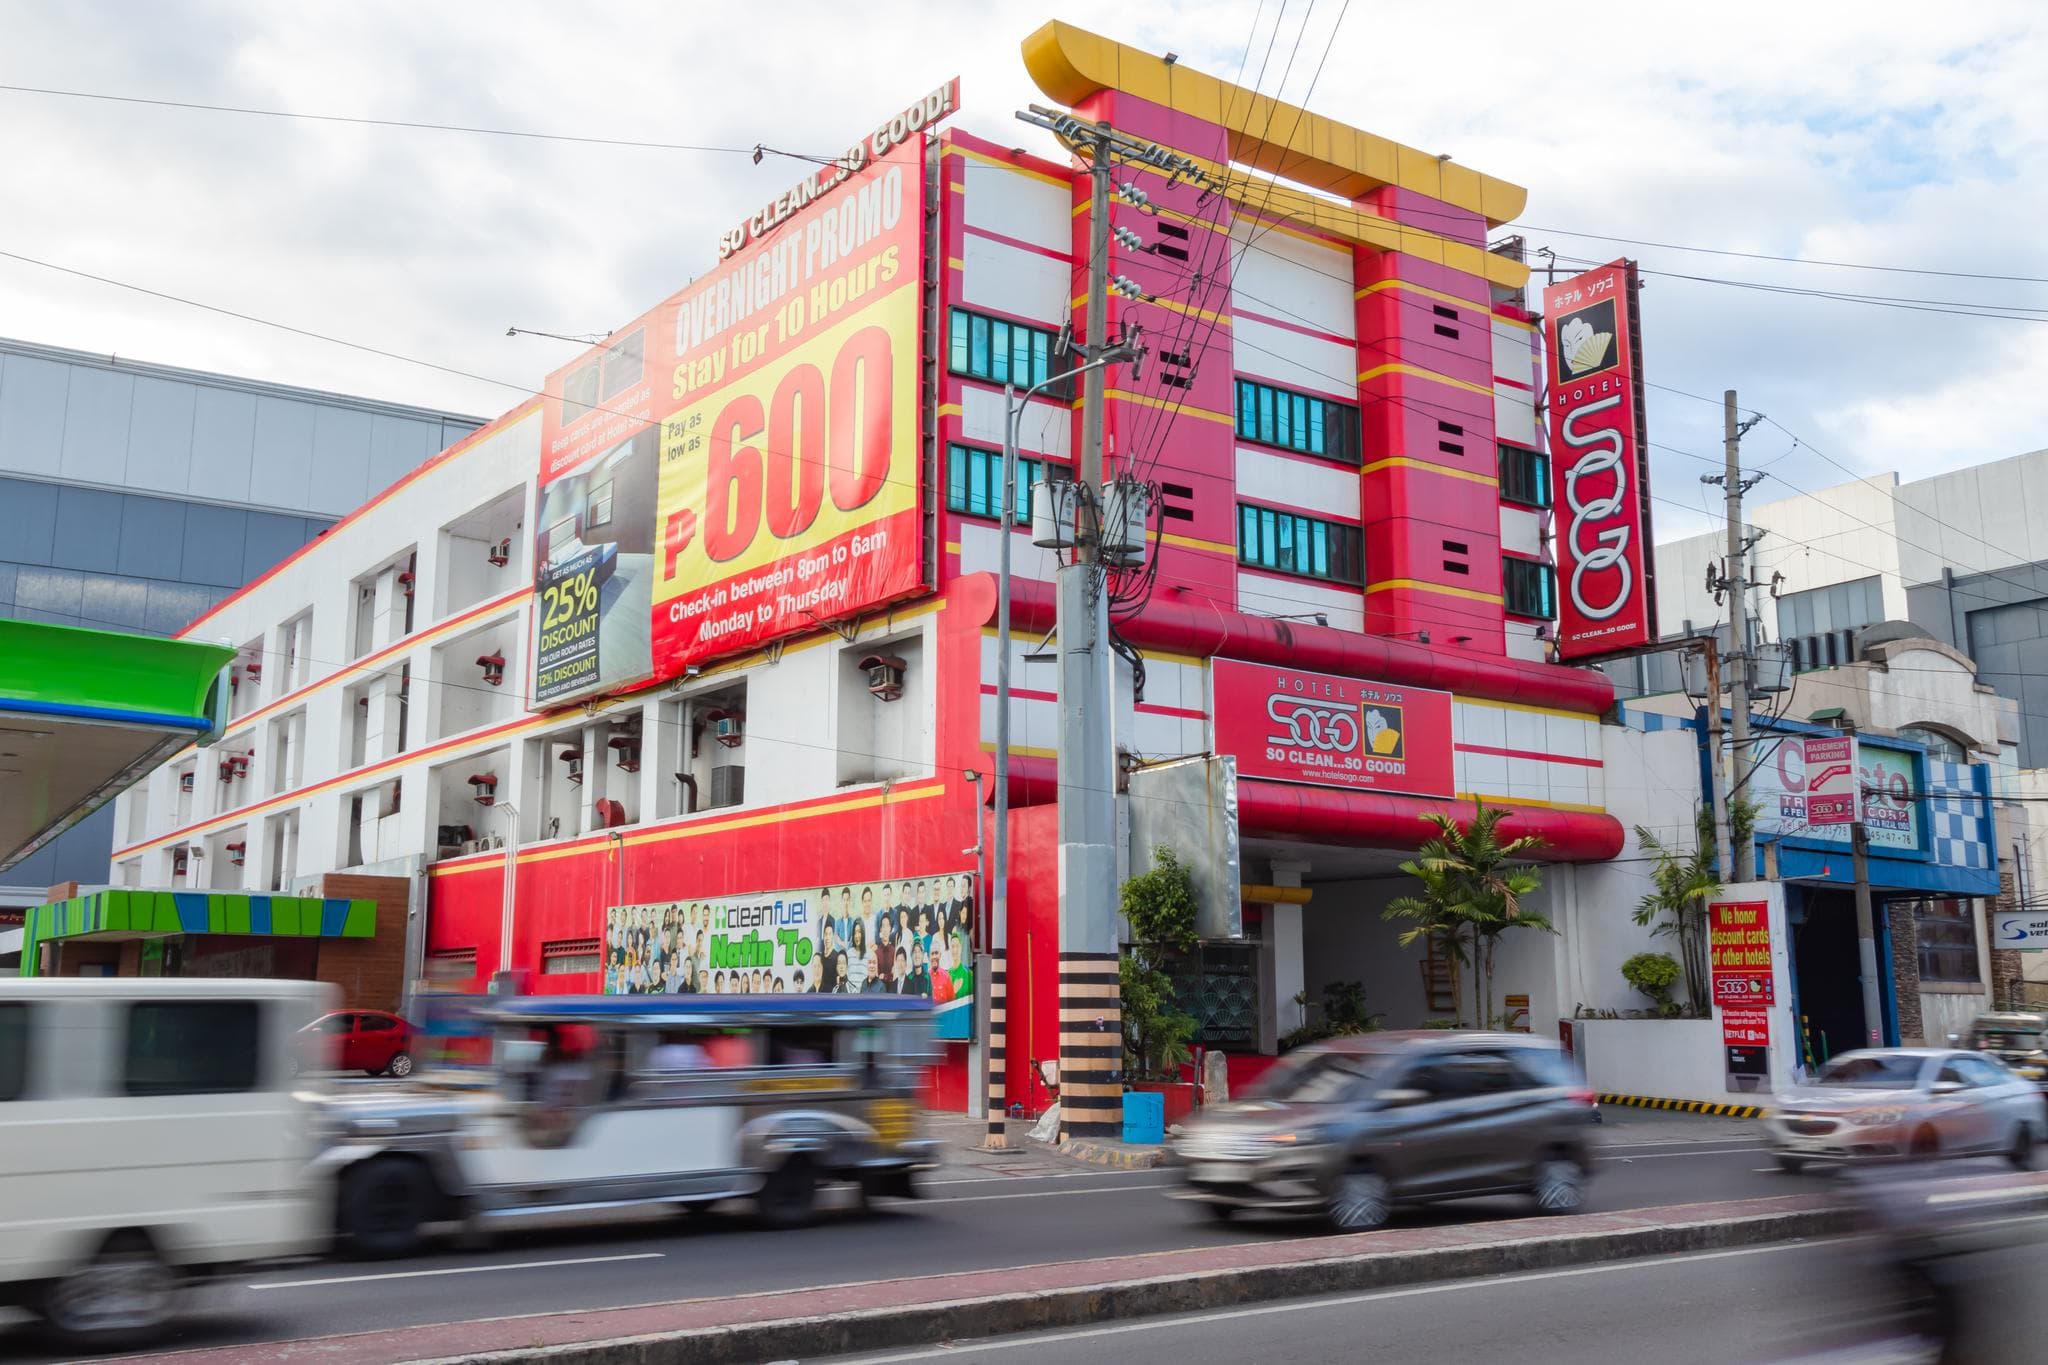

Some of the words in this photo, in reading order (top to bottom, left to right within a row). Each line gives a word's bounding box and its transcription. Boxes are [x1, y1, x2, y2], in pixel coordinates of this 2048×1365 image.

[719, 222, 748, 259] SO
[871, 79, 954, 157] GOOD!
[675, 229, 803, 357] OVERNIGHT
[804, 165, 903, 280] PROMO
[1553, 288, 1582, 309] ホテル
[1587, 273, 1615, 298] ソウゴ
[672, 345, 727, 400] Stay
[731, 321, 770, 370] for
[774, 295, 806, 345] 10
[810, 244, 900, 326] Hours
[1558, 376, 1622, 407] HOTEL
[668, 418, 687, 440] Pay
[689, 412, 702, 427] as
[550, 447, 580, 474] discount
[580, 435, 597, 456] card
[597, 431, 606, 446] at
[667, 443, 686, 462] low
[688, 434, 701, 452] as
[1562, 393, 1634, 621] SOGO
[669, 588, 728, 623] Check-in
[730, 565, 794, 601] between
[797, 552, 830, 580] 8pm
[832, 545, 847, 564] to
[851, 530, 887, 558] 6am
[543, 567, 598, 631] 25%
[699, 609, 754, 642] Monday
[757, 603, 773, 623] to
[776, 577, 848, 617] Thursday
[540, 613, 598, 652] DISCOUNT
[1572, 633, 1581, 641] SO
[1616, 622, 1637, 632] GOOD!
[540, 655, 549, 665] ON
[549, 650, 561, 662] OUR
[560, 643, 578, 657] ROOM
[578, 636, 596, 650] RATES
[538, 672, 553, 688] 12%
[553, 655, 597, 683] DISCOUNT
[1278, 677, 1345, 698] HOTEL
[1267, 692, 1359, 753] SOGO
[1265, 747, 1286, 762] SO
[1365, 759, 1406, 775] GOOD!
[1806, 741, 1849, 753] BASEMENT
[1810, 750, 1846, 761] PARKING
[1302, 768, 1375, 784] www.hotelsogo.com
[1867, 807, 1909, 822] CORP.
[727, 898, 808, 929] cleanfuel
[1720, 905, 1733, 925] We
[1733, 906, 1757, 925] honor
[709, 928, 774, 970] Natin
[1711, 926, 1745, 945] discount
[1746, 926, 1769, 945] cards
[1712, 947, 1720, 966] of
[1722, 947, 1744, 966] other
[1745, 946, 1770, 966] hotels
[1716, 978, 1748, 994] SOGO
[1724, 1029, 1746, 1040] NETFLIX
